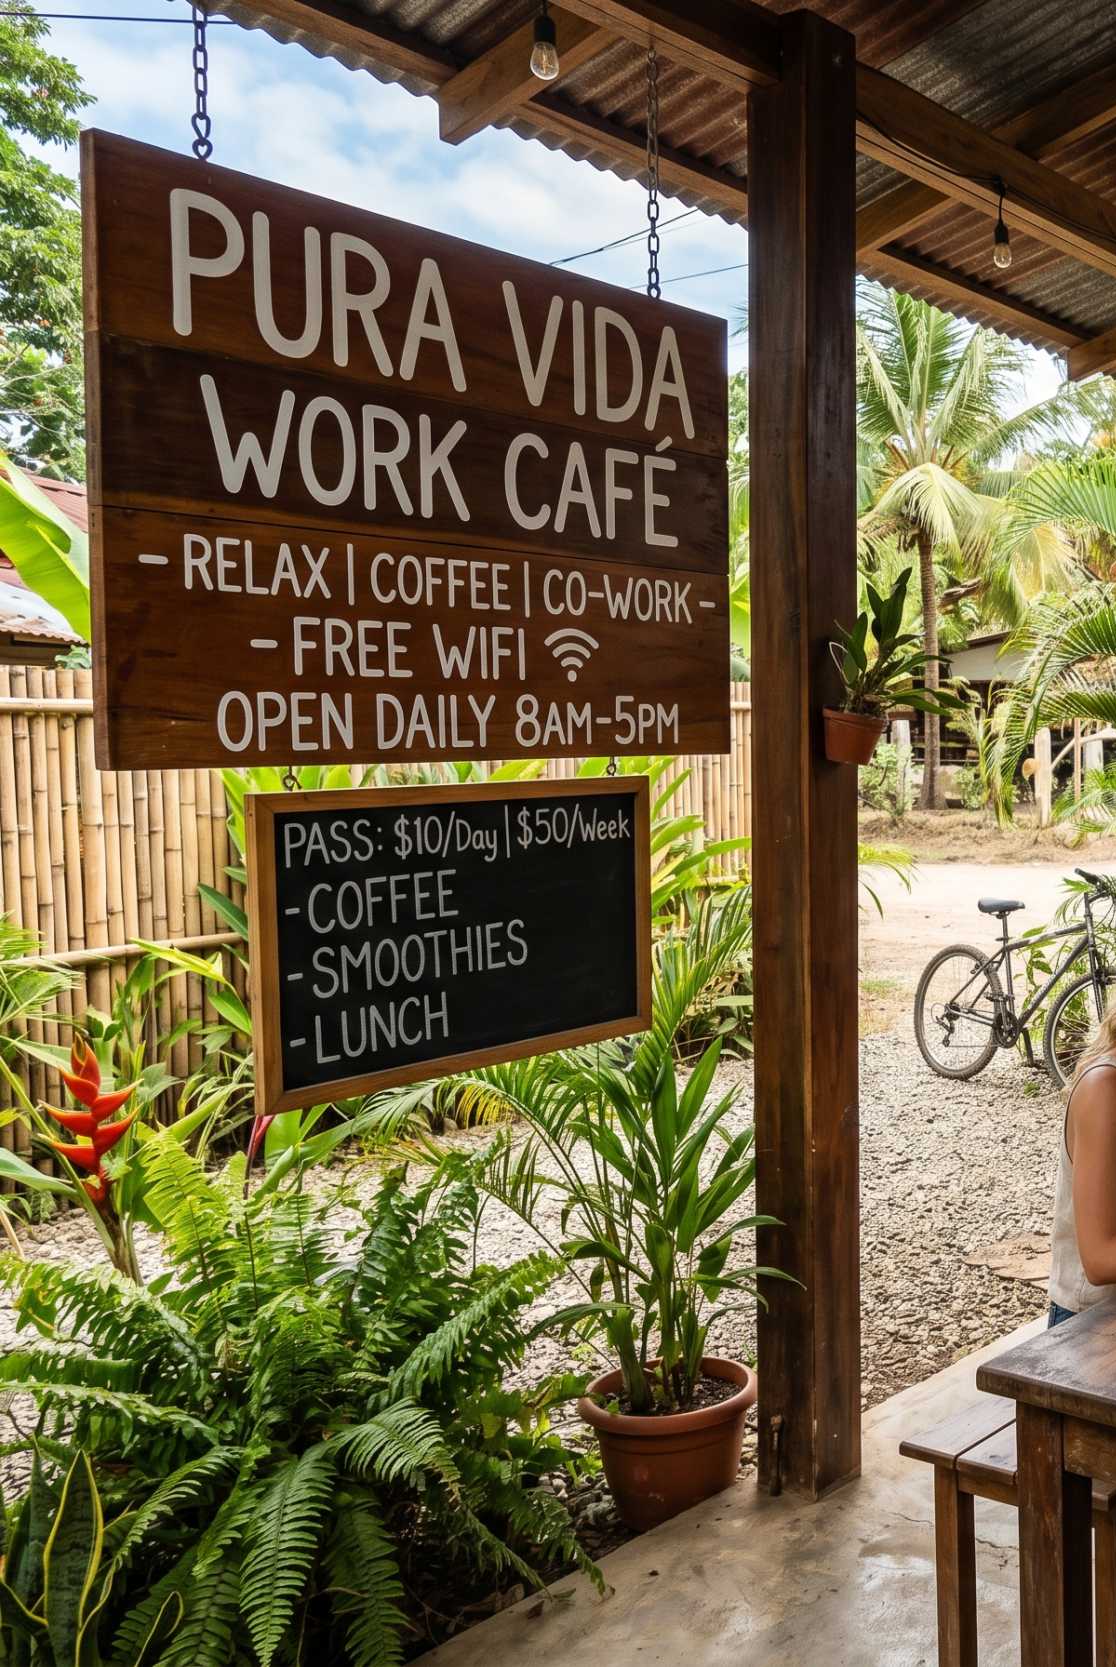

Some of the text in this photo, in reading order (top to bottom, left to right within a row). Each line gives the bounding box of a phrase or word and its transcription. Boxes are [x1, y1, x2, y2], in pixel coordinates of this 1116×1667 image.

[169, 188, 695, 440] PURA VIDA
[199, 374, 679, 548] WORK CAFÉ
[183, 533, 332, 599] RELAX
[370, 552, 511, 611] COFFEE
[293, 616, 413, 678] FREE
[432, 623, 526, 681] WIFI
[217, 690, 679, 752] OPEN DAILY 8AM-5PM
[284, 819, 384, 868] PASS:
